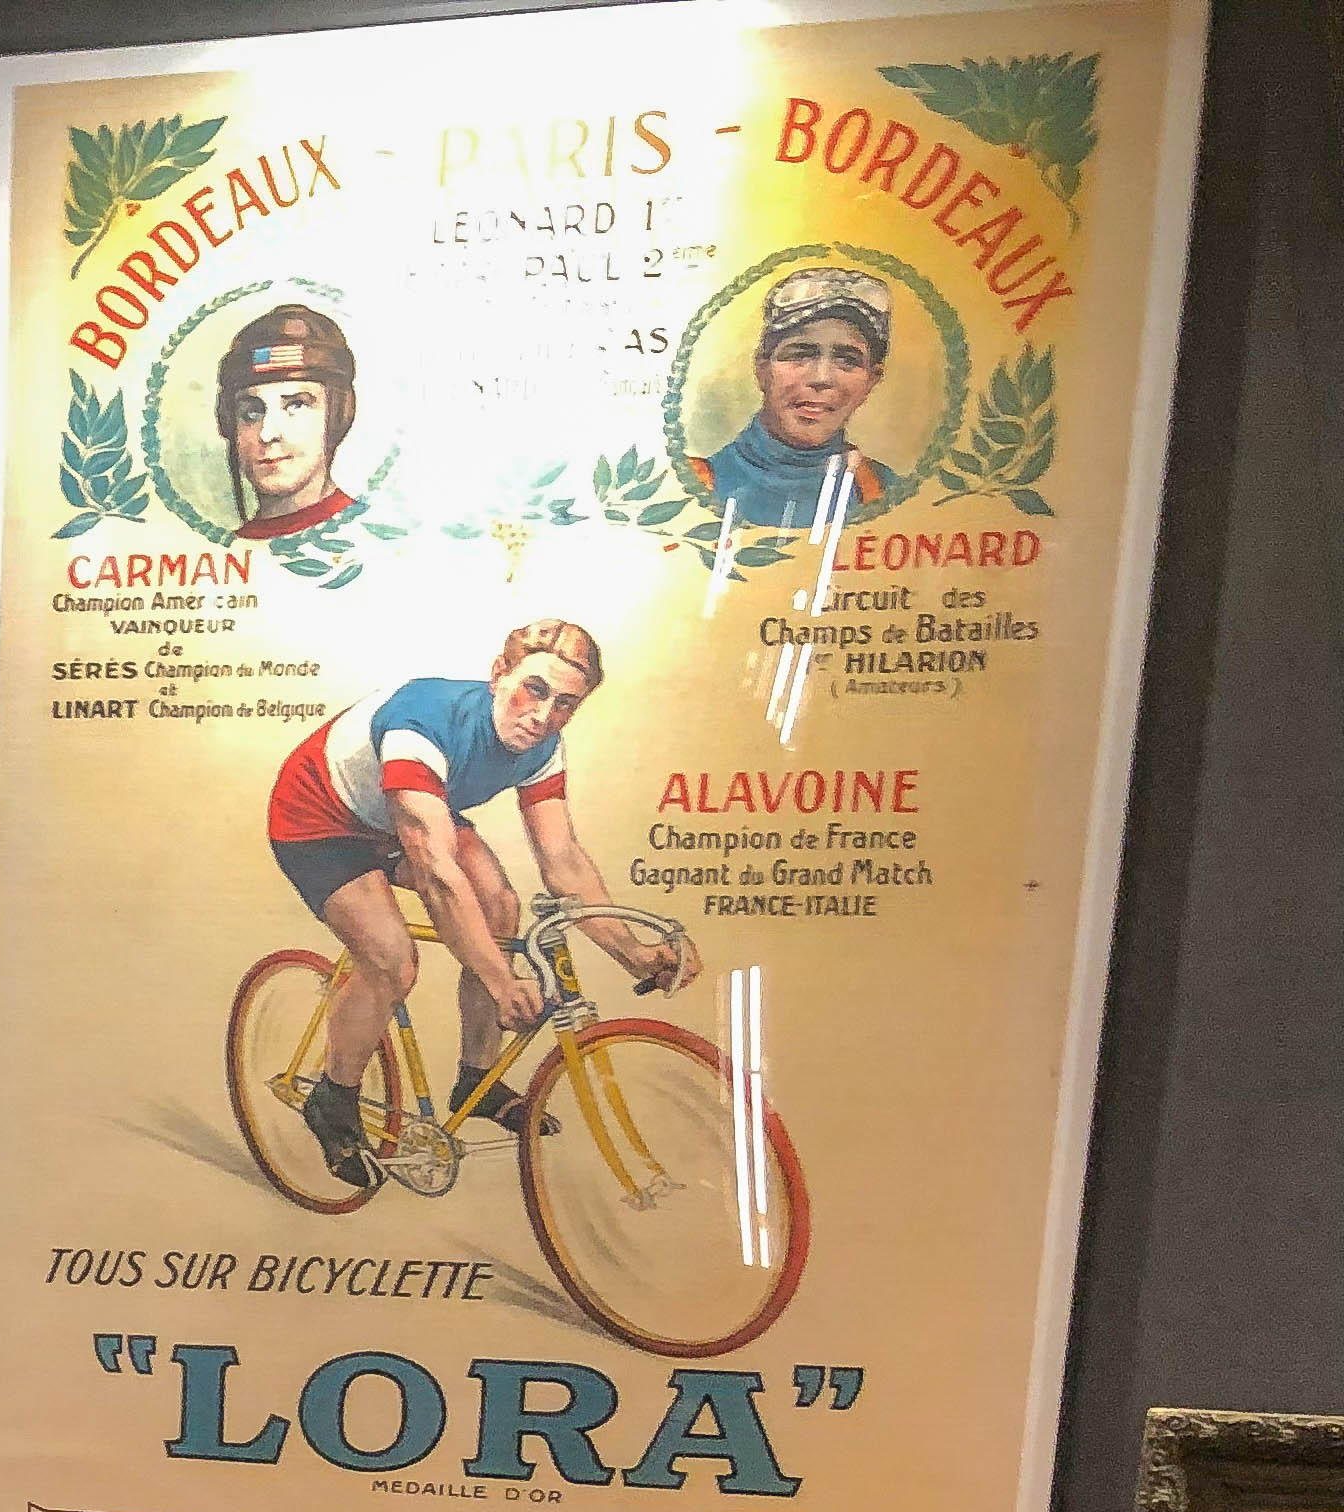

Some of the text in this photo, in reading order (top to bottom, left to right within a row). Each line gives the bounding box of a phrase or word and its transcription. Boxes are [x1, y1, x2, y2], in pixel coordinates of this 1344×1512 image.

[69, 134, 341, 370] BORDEAUX
[774, 97, 1073, 336] BORDEAUX
[67, 549, 253, 589] CARMAN
[52, 592, 145, 616] Champion
[942, 587, 986, 610] des
[109, 619, 237, 636] VAINQUEUR
[760, 611, 1040, 649] Champs de Batailles
[158, 641, 184, 657] de
[144, 660, 233, 682] Champion
[259, 660, 321, 677] Monde
[844, 650, 987, 674] HILARION
[52, 700, 139, 719] LINART
[149, 699, 233, 723] Champion
[256, 699, 327, 723] Belgique
[656, 768, 920, 815] ALAVOINE
[648, 823, 917, 857] Champion de France
[629, 858, 934, 894] Gagnant du Grand Match
[703, 894, 879, 917] FRANCE-ITALIE
[44, 1247, 496, 1301] TOUS SUR BICYCLETTE
[372, 1479, 488, 1500] MEDAILLE
